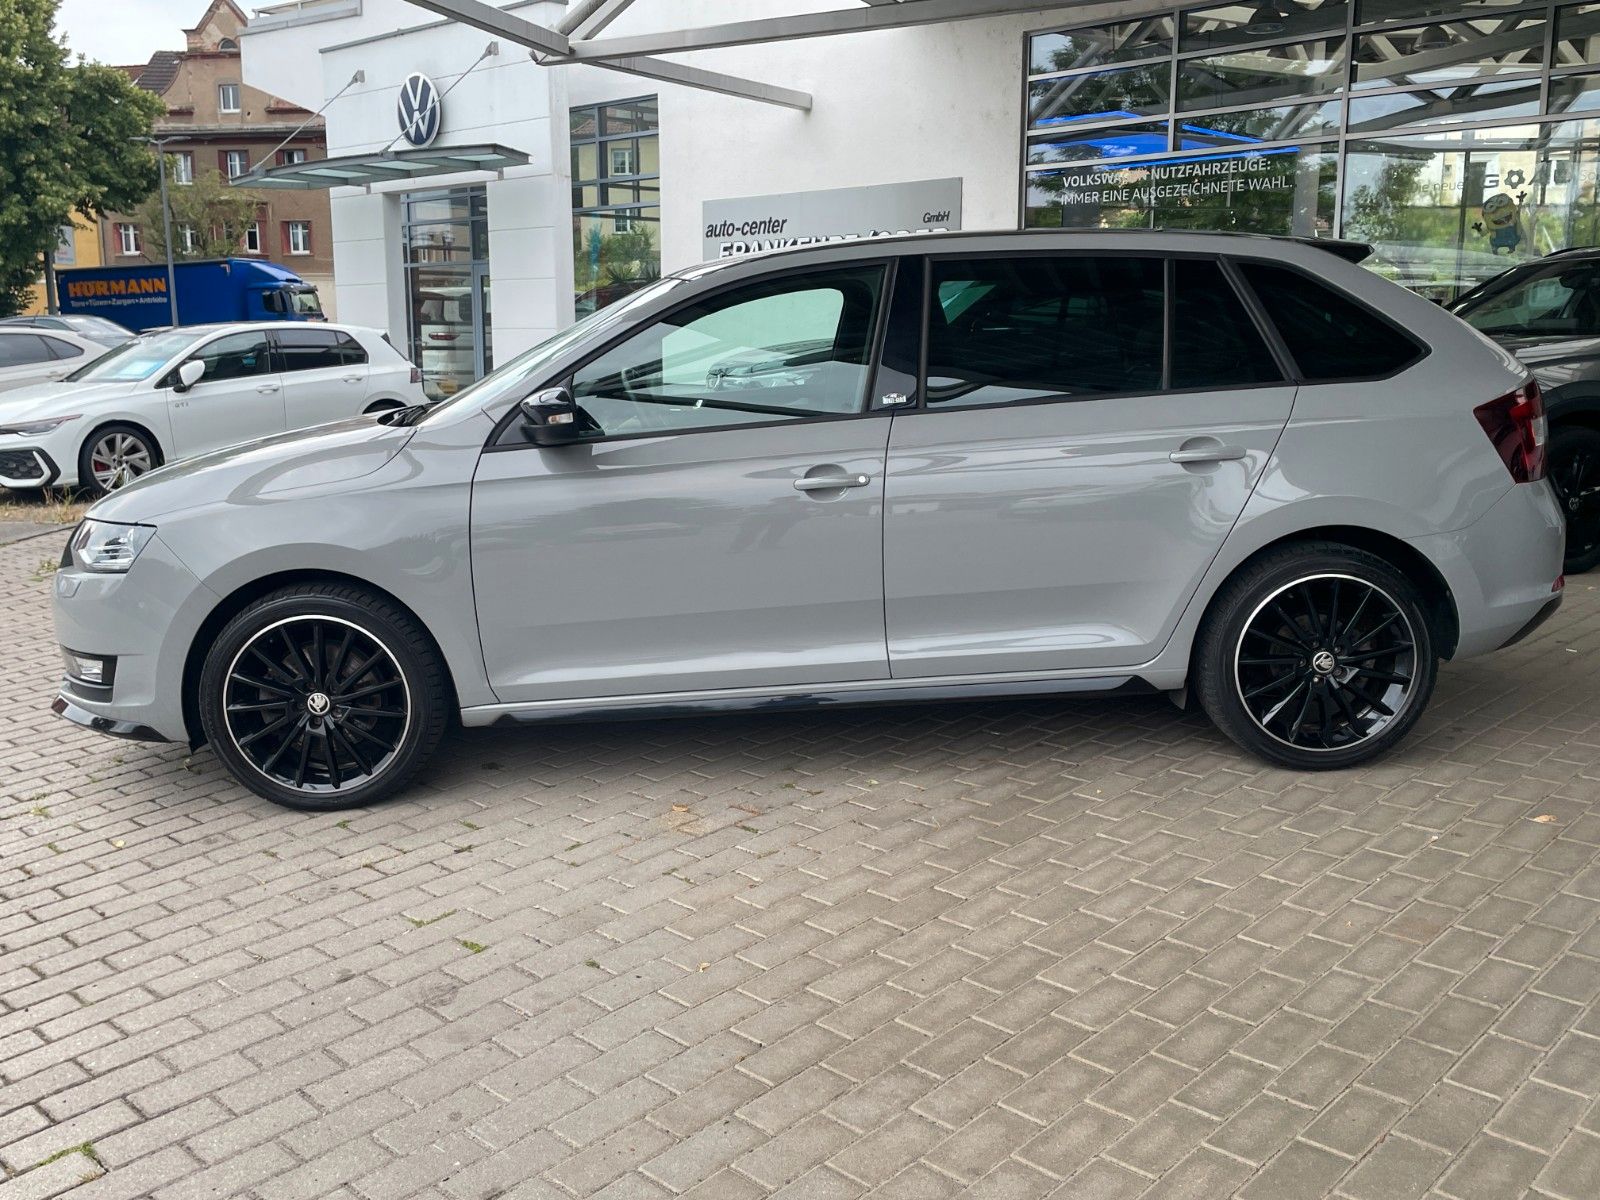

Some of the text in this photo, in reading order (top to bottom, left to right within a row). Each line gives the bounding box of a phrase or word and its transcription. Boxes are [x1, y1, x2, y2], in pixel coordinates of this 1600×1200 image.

[1062, 158, 1271, 188] VOLKSWAN NUTZFAHRZEUGE:
[1061, 175, 1293, 205] IMMER EINE AUSGEZEICHNETE WAHL.
[705, 216, 788, 238] auto-center
[922, 210, 951, 224] GmbH
[718, 234, 859, 259] FRANK
